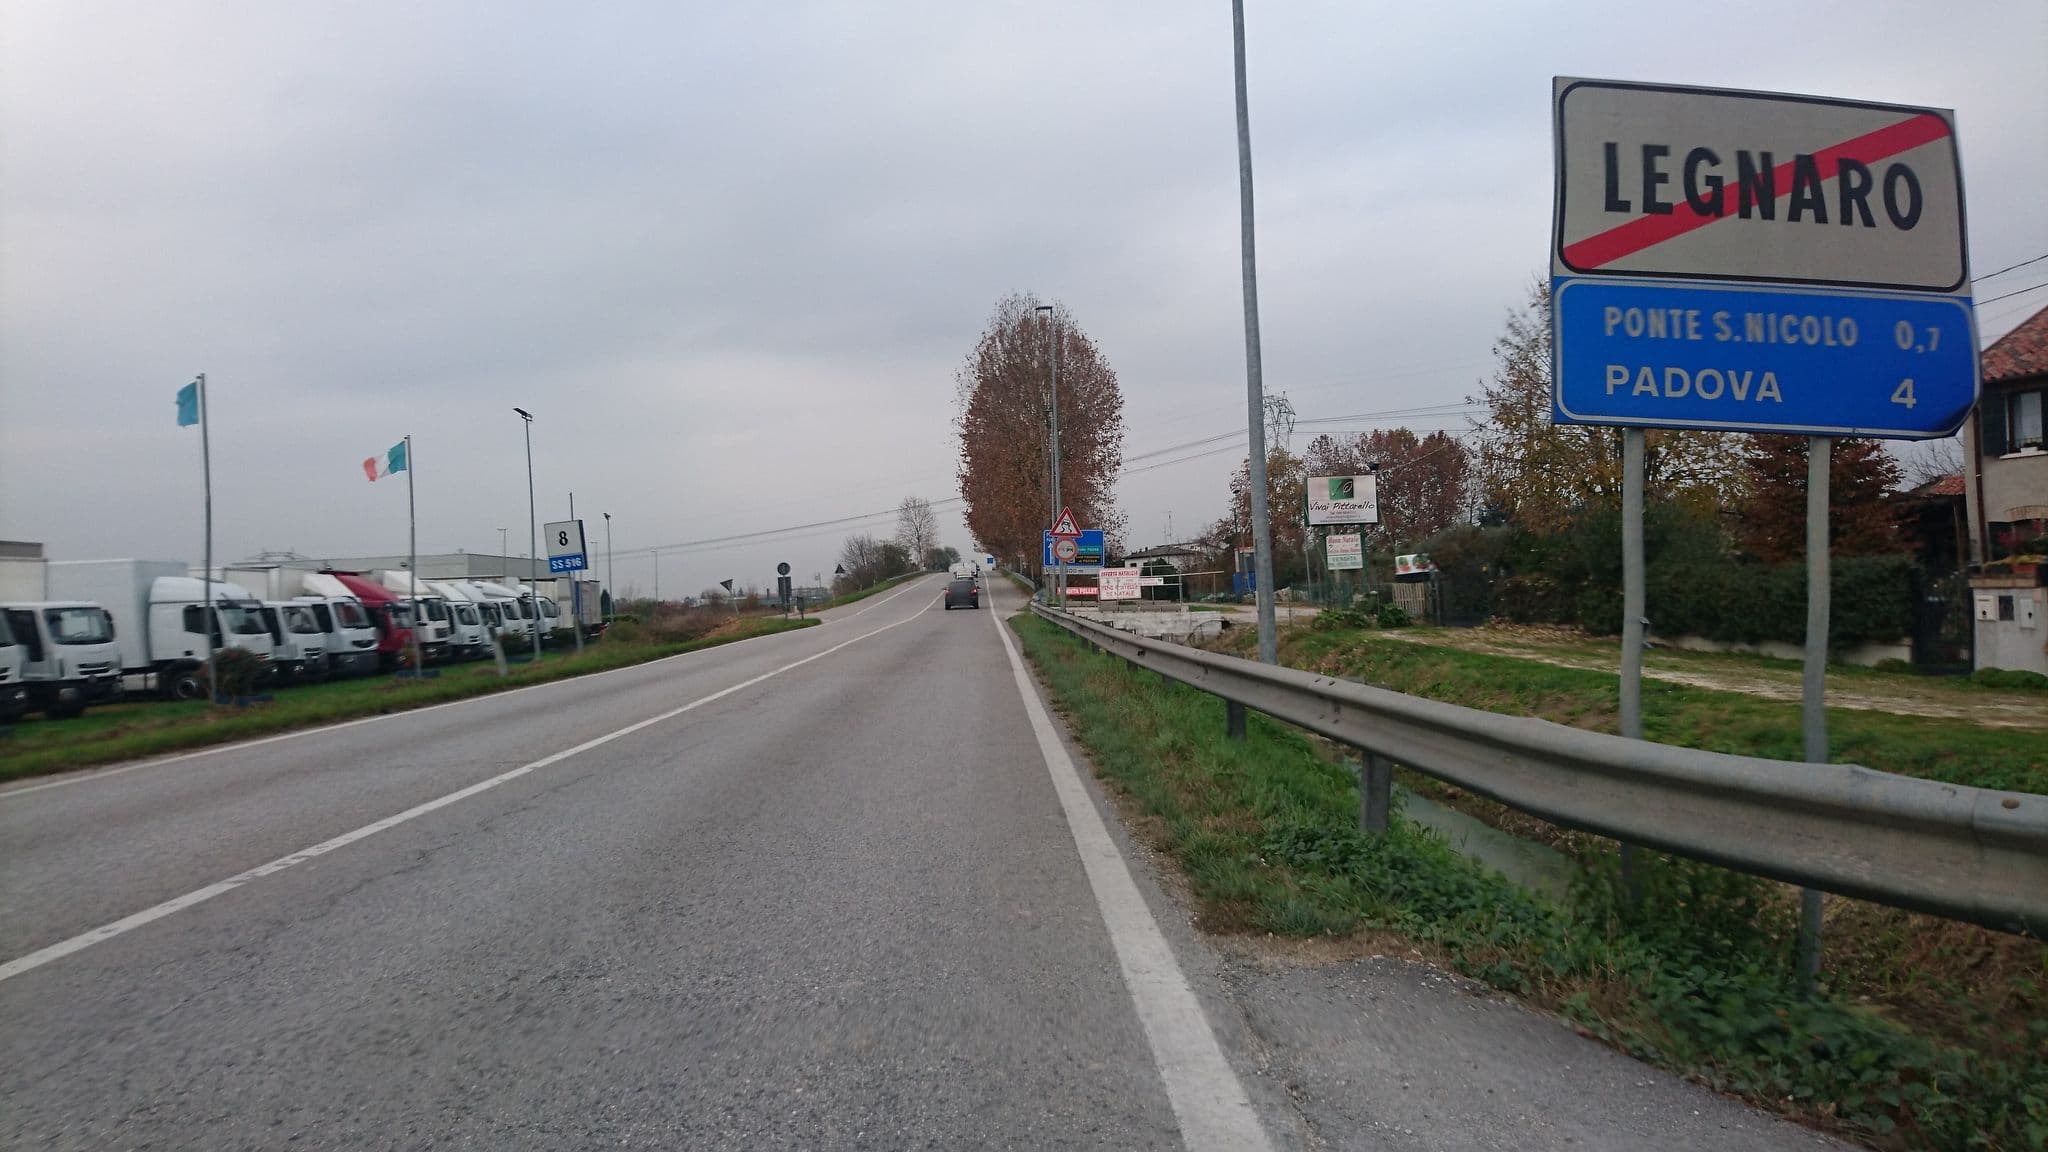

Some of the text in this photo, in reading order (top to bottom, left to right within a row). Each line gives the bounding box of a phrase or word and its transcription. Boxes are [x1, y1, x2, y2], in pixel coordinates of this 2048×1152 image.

[1604, 142, 1923, 231] LEGNARO
[1604, 306, 1703, 342] PONTE
[1894, 320, 1941, 354] 0,7
[1605, 365, 1917, 409] PADOVA 4
[1310, 501, 1375, 511] Vivai Pittarello
[559, 531, 568, 546] 8
[552, 557, 582, 570] SS 516
